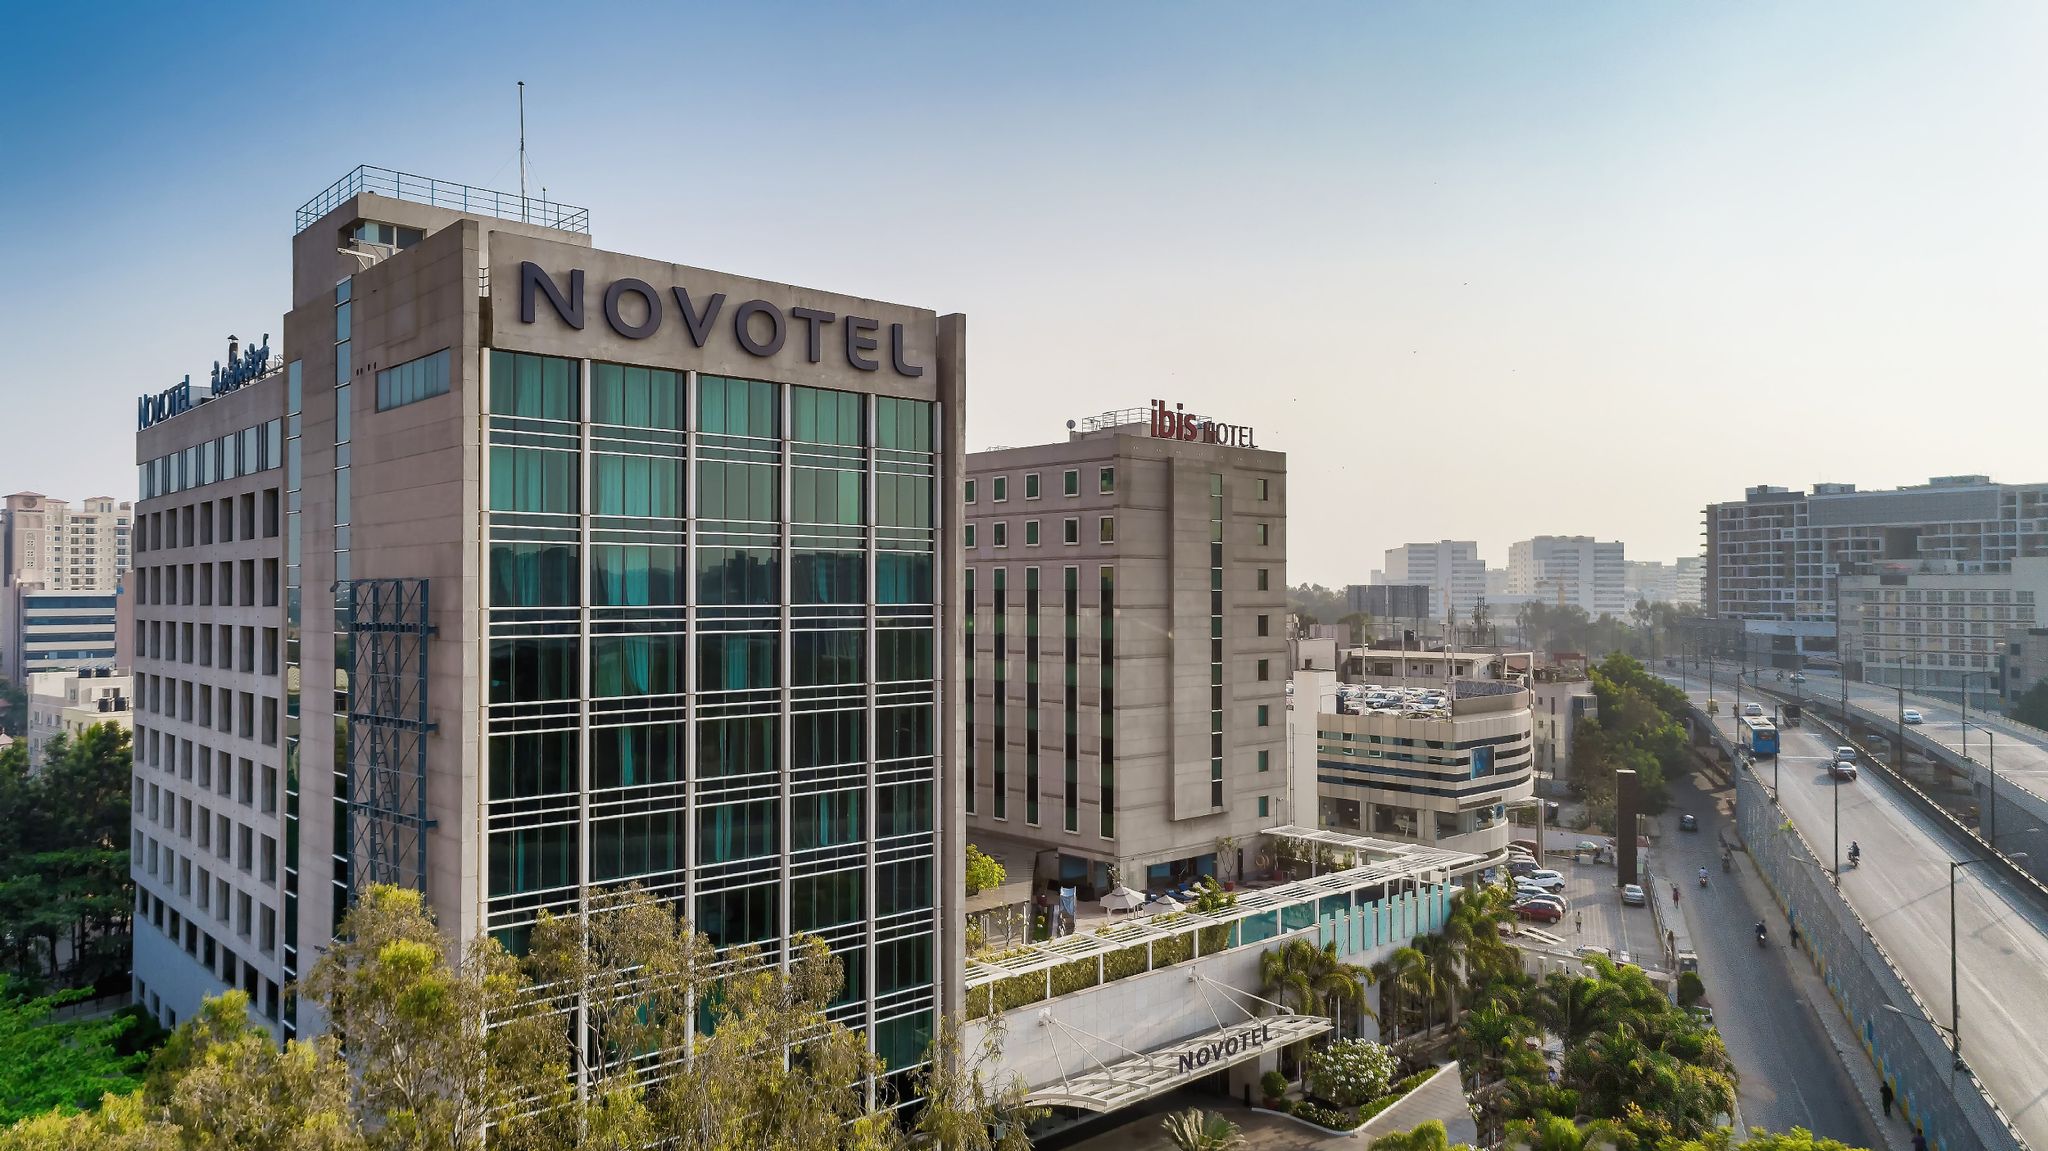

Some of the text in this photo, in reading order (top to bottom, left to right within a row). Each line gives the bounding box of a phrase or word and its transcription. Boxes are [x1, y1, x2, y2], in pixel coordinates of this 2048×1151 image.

[521, 260, 923, 377] NOVOTEL
[1151, 399, 1258, 448] ibis HOTEL
[1179, 1024, 1273, 1074] NOVOTEL
